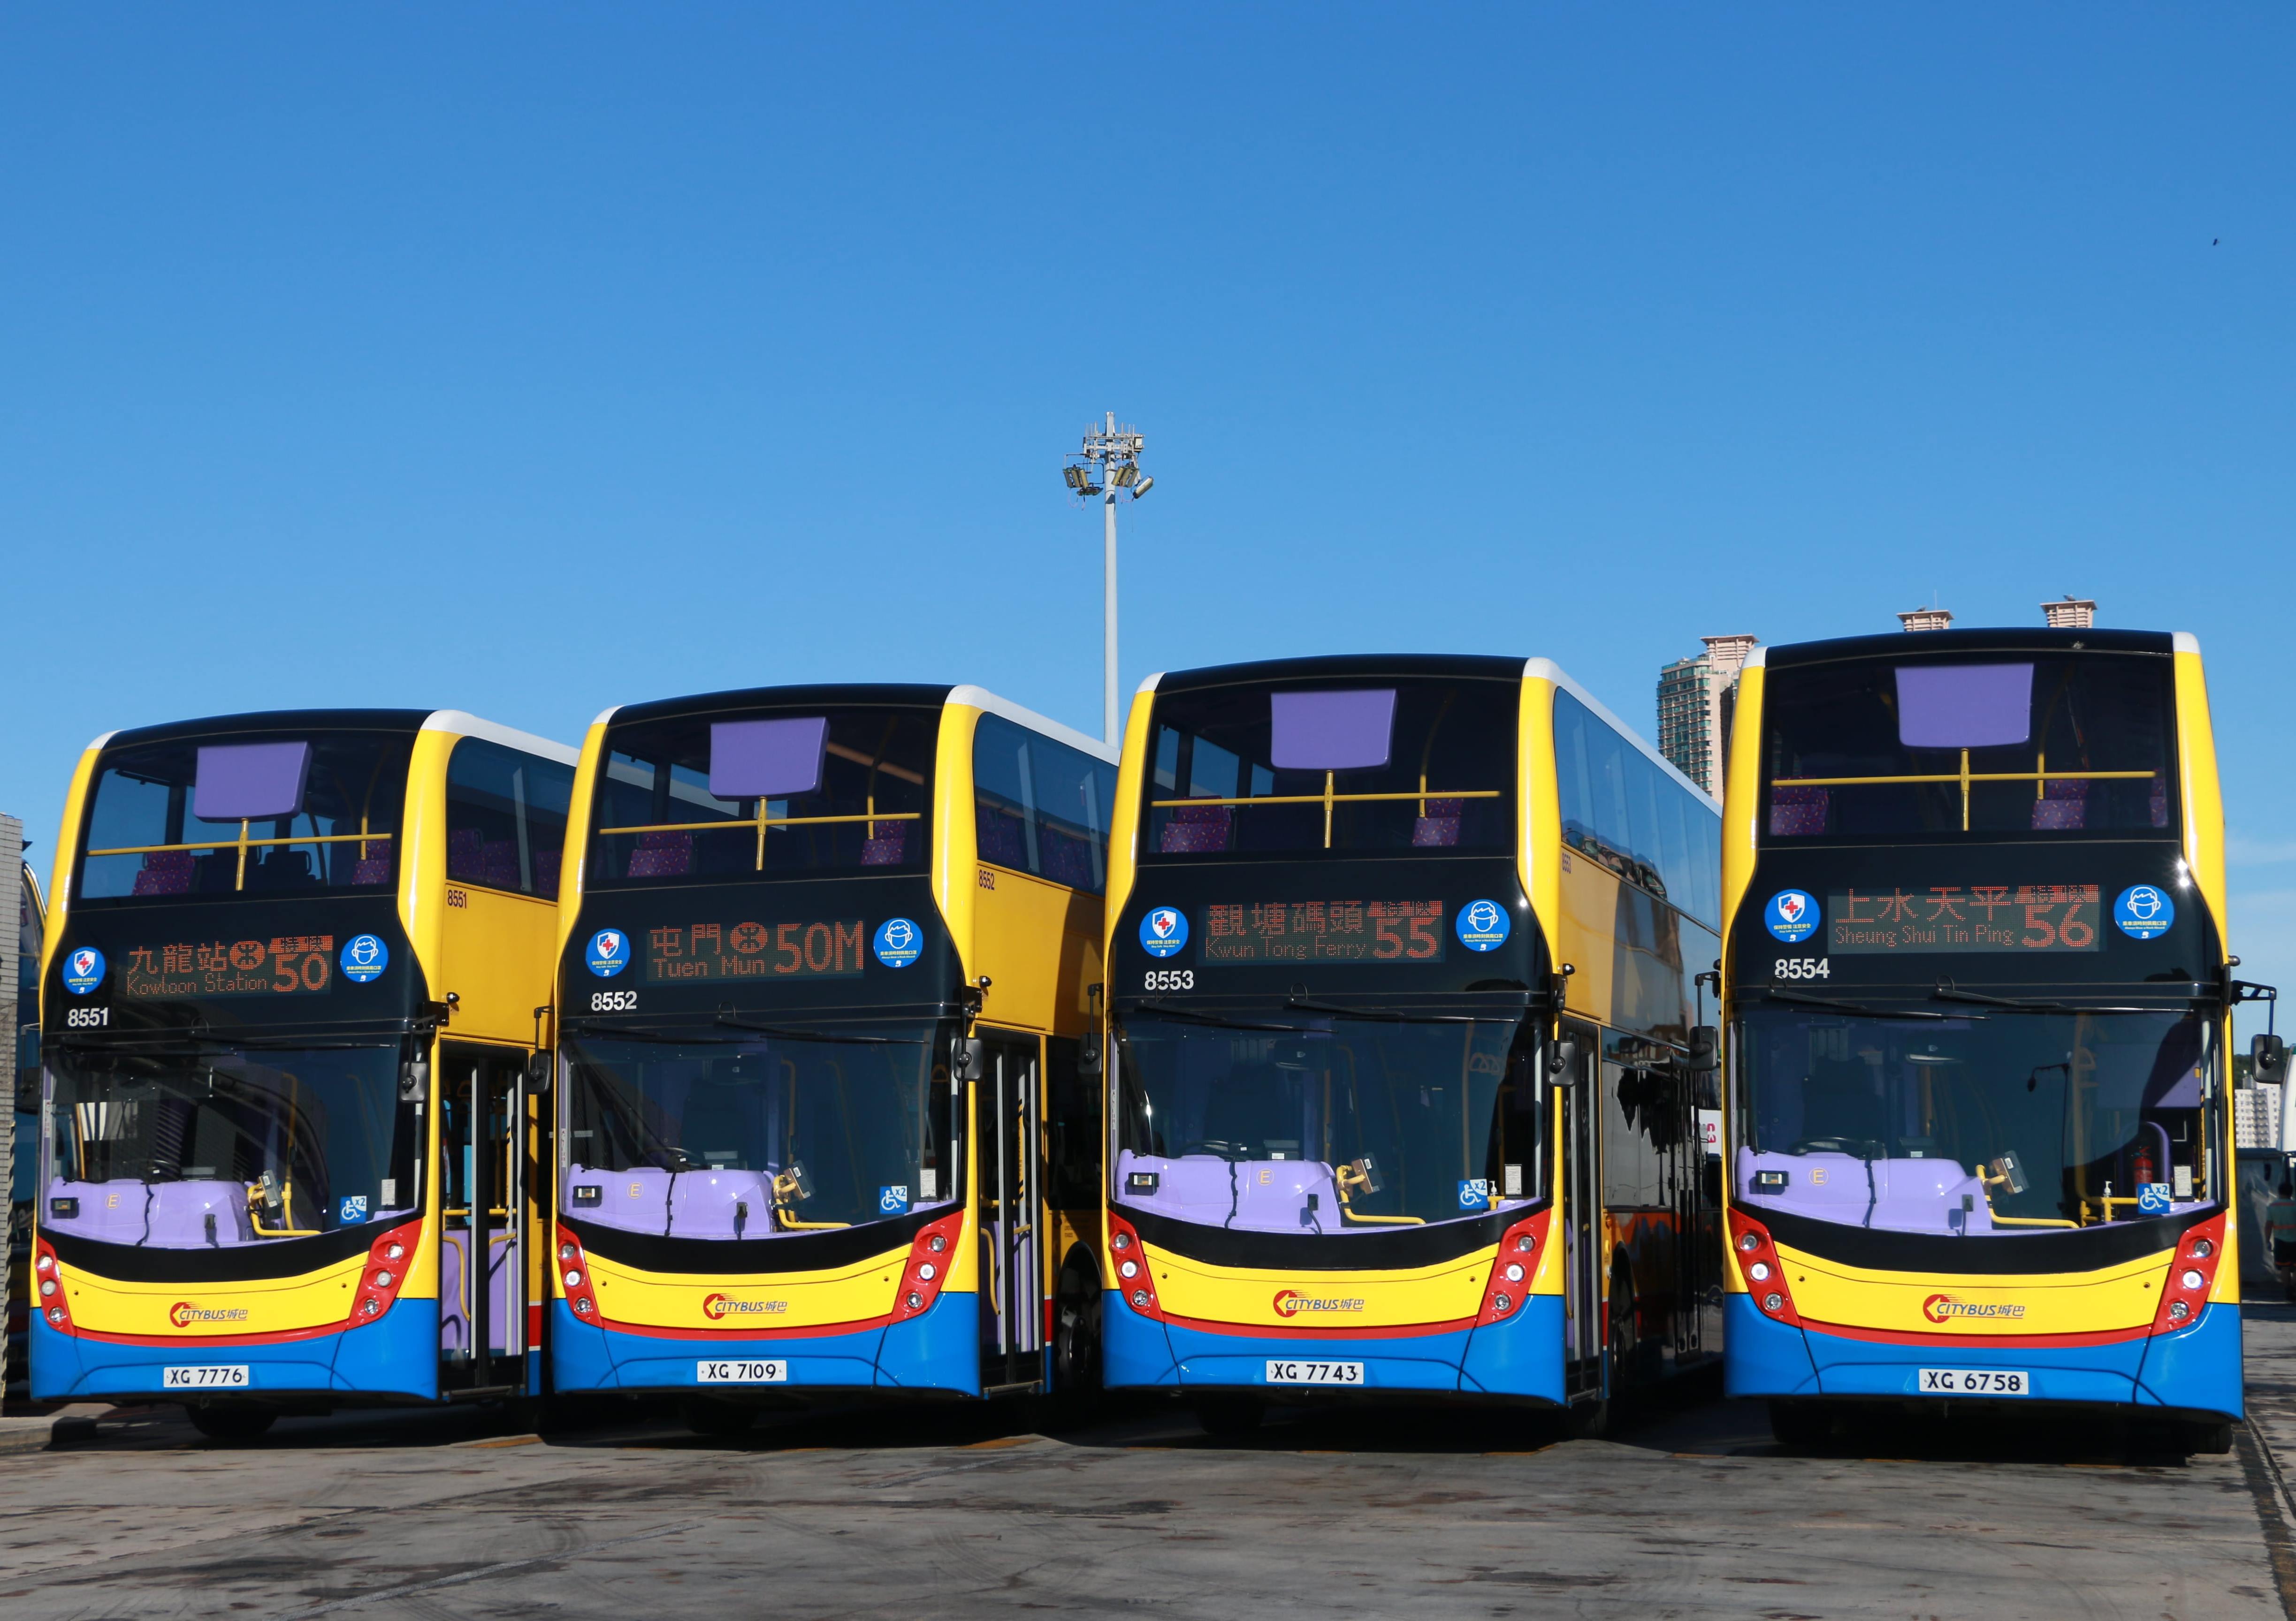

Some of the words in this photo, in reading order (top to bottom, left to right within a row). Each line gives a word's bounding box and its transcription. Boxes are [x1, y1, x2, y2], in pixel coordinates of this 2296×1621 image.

[979, 869, 995, 890] 8552
[448, 889, 467, 909] 8551
[1836, 886, 2011, 923] 上水天平
[1208, 901, 1364, 936] 觀塘碼頭
[2021, 904, 2093, 947] 56
[650, 923, 721, 957] 屯門
[1373, 917, 1437, 958] 55
[1836, 926, 1897, 947] Sheung
[1902, 925, 1935, 943] Shui
[1943, 925, 1968, 942] Tin
[1976, 925, 2014, 946] Ping
[128, 941, 227, 974] 九龍站
[774, 921, 863, 973] 50M
[1206, 937, 1254, 957] Kwun
[1260, 936, 1307, 959] Tong
[1315, 935, 1366, 959] Ferry
[272, 953, 328, 992] 50
[653, 958, 708, 977] Tuen
[721, 955, 765, 975] Mun
[1774, 958, 1830, 979] 8554
[127, 975, 196, 995] Kowloon
[205, 972, 267, 991] Station
[1144, 970, 1194, 990] 8553
[591, 990, 637, 1011] 8552
[68, 1007, 108, 1027] 8551
[1260, 1170, 1270, 1183] E
[1813, 1169, 1824, 1183] E
[630, 1184, 641, 1197] E
[108, 1195, 118, 1208] E
[180, 1309, 226, 1320] CITYBUS
[227, 1308, 248, 1319] 城巴
[715, 1301, 764, 1312] CITYBUS
[765, 1301, 787, 1311] 城巴
[1286, 1299, 1339, 1309] CITYBUS
[1340, 1298, 1364, 1309] 城巴
[1937, 1303, 1997, 1316] CITYBUS
[1997, 1304, 2025, 1317] 城巴
[170, 1369, 190, 1384] XG
[198, 1368, 242, 1384] 7776
[708, 1363, 729, 1378] XG
[737, 1363, 776, 1378] 7109
[1274, 1363, 1297, 1379] XG
[1306, 1364, 1356, 1381] 7743
[1927, 1371, 1953, 1389] XG
[1964, 1373, 2020, 1392] 6758
